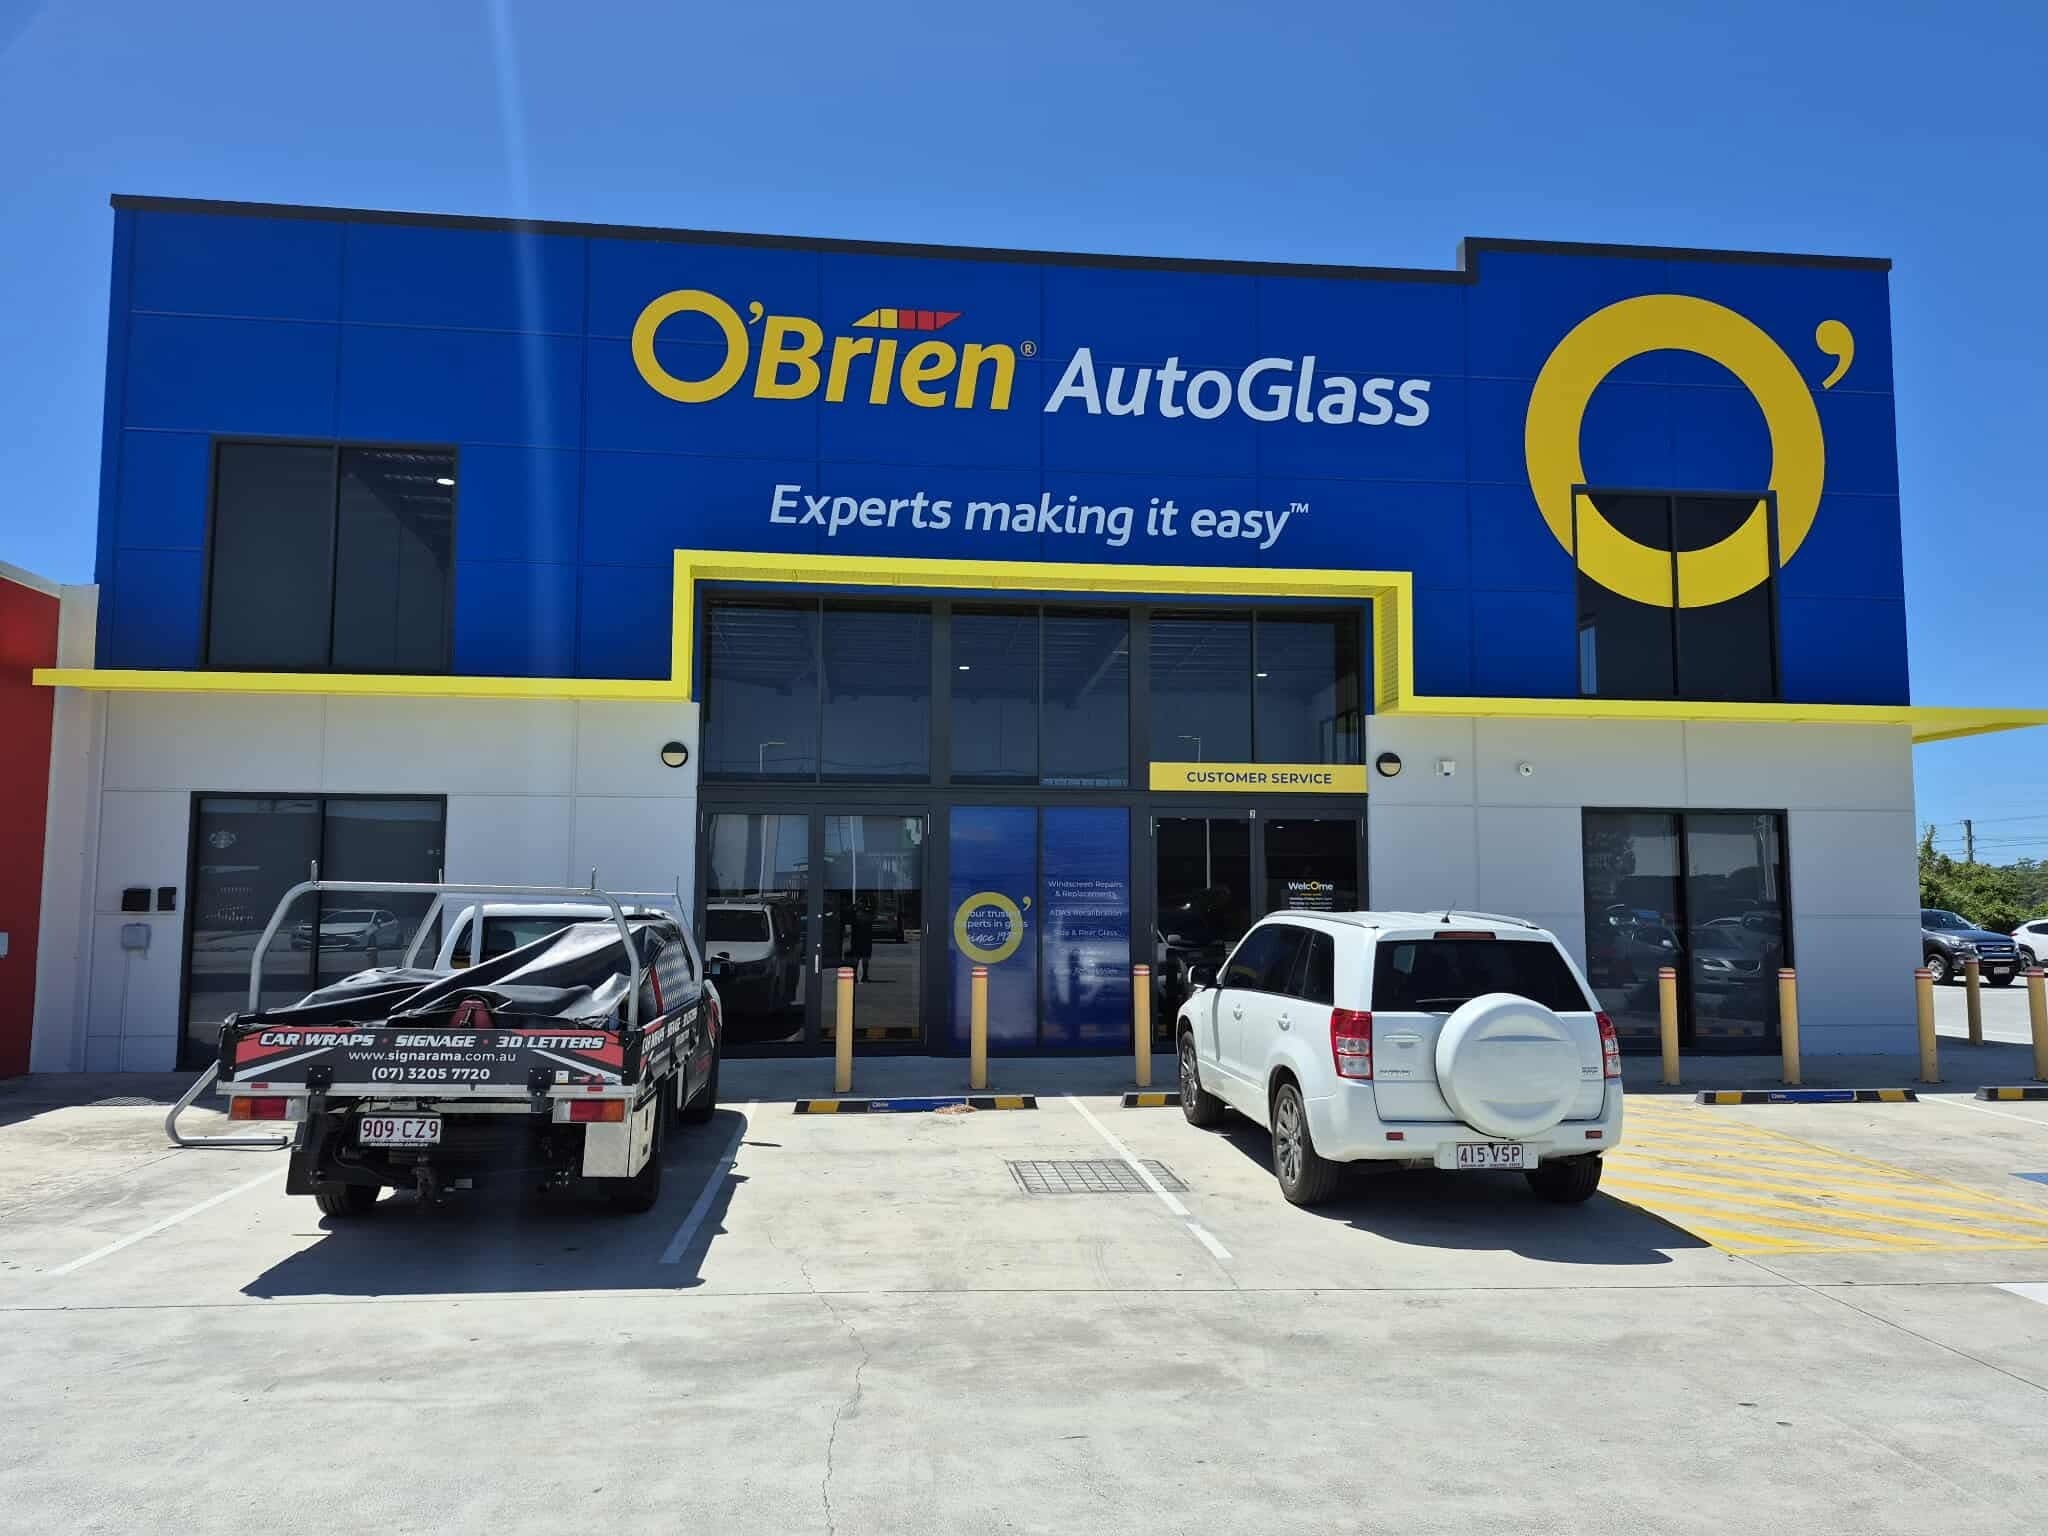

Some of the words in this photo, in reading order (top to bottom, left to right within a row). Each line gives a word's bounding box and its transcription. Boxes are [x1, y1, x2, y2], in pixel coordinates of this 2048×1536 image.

[1044, 347, 1431, 427] AutoGlass
[770, 484, 952, 536] Experts
[965, 492, 1134, 547] making
[1147, 498, 1178, 536] it
[1186, 771, 1267, 784] CUSTOMER
[1271, 773, 1333, 785] SERVICE
[260, 1033, 300, 1046] CAR
[305, 1033, 376, 1047] WRAPS
[394, 1035, 477, 1048] SIGNAGE
[496, 1036, 522, 1048] 3D
[526, 1036, 605, 1049] LETTERS
[348, 1050, 516, 1063] www.signarama.com.au
[371, 1067, 404, 1080] (07)
[407, 1068, 447, 1080] 3205
[451, 1068, 491, 1080] 7720
